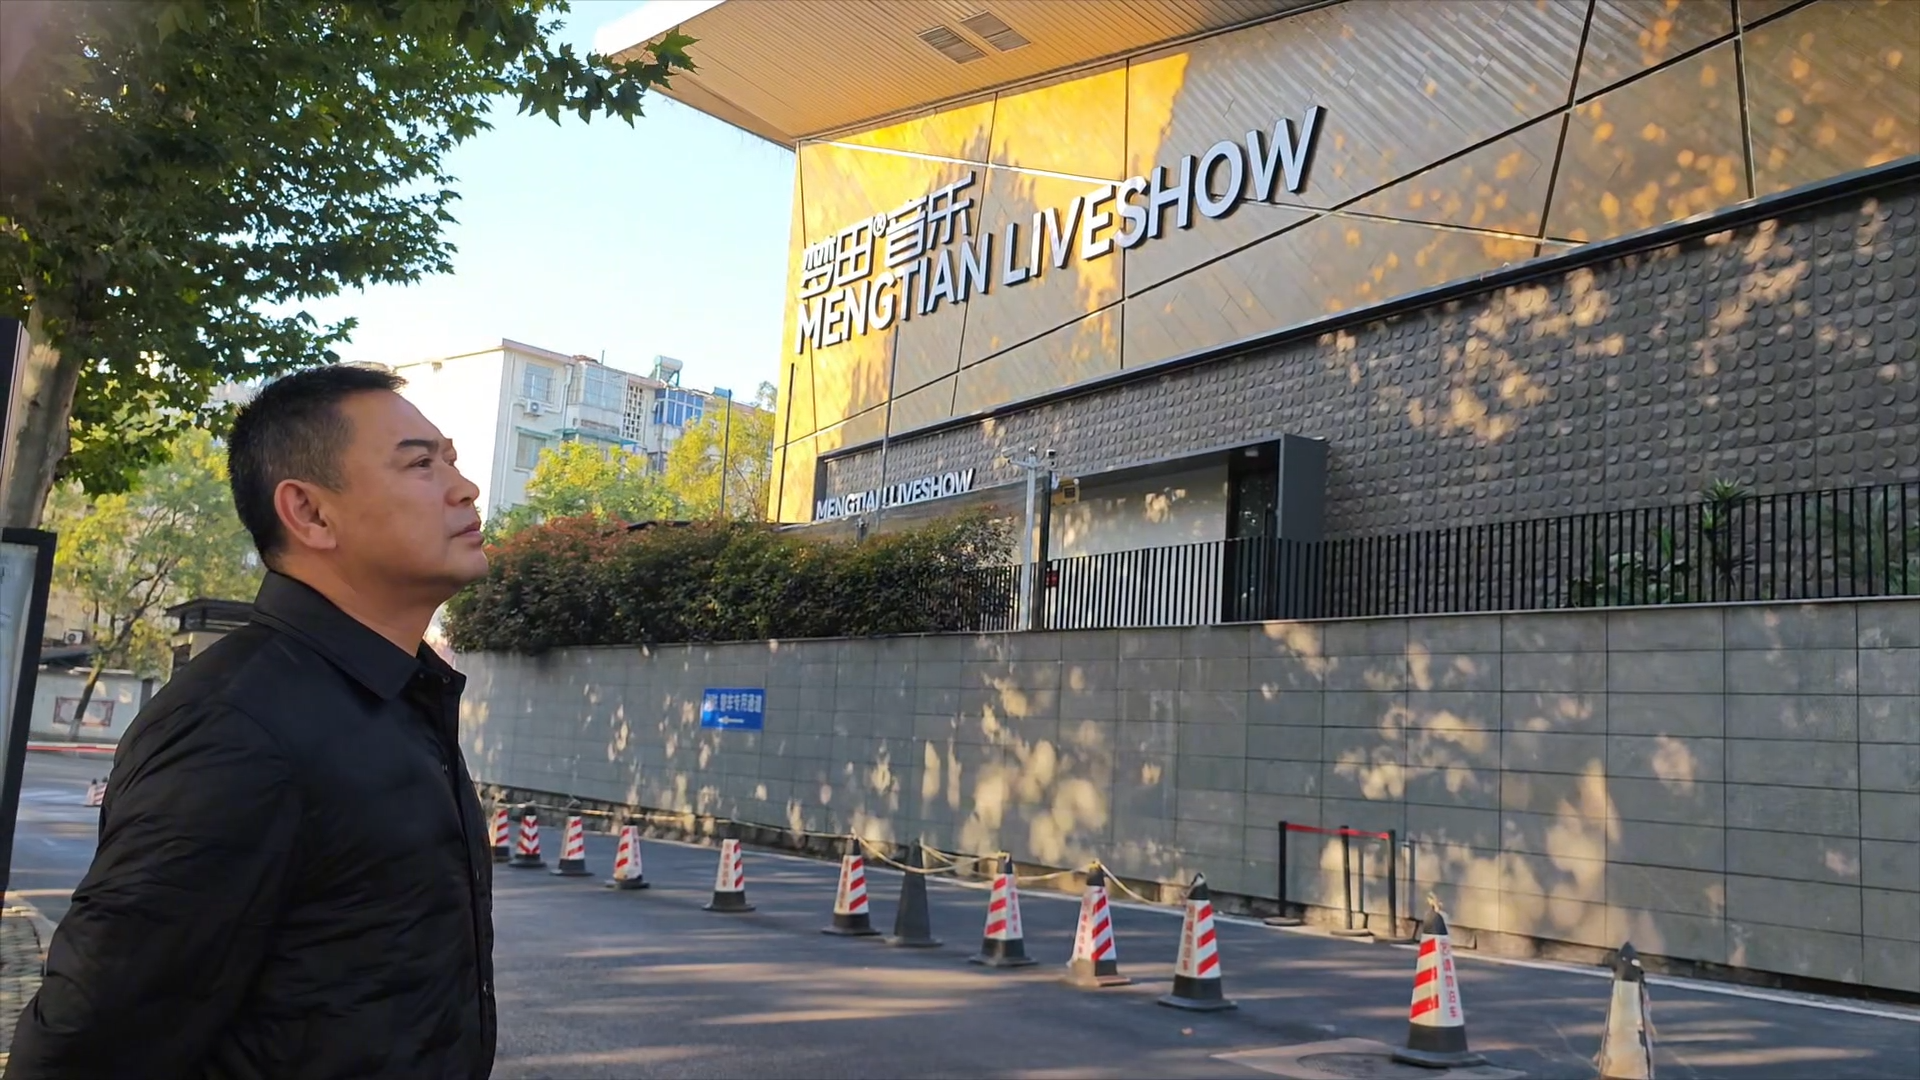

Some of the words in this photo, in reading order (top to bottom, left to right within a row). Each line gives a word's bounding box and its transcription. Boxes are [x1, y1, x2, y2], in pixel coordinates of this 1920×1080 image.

[795, 232, 992, 354] MENGTIAN
[1002, 105, 1326, 286] LIVESHOW
[888, 468, 976, 507] LIVESHOW
